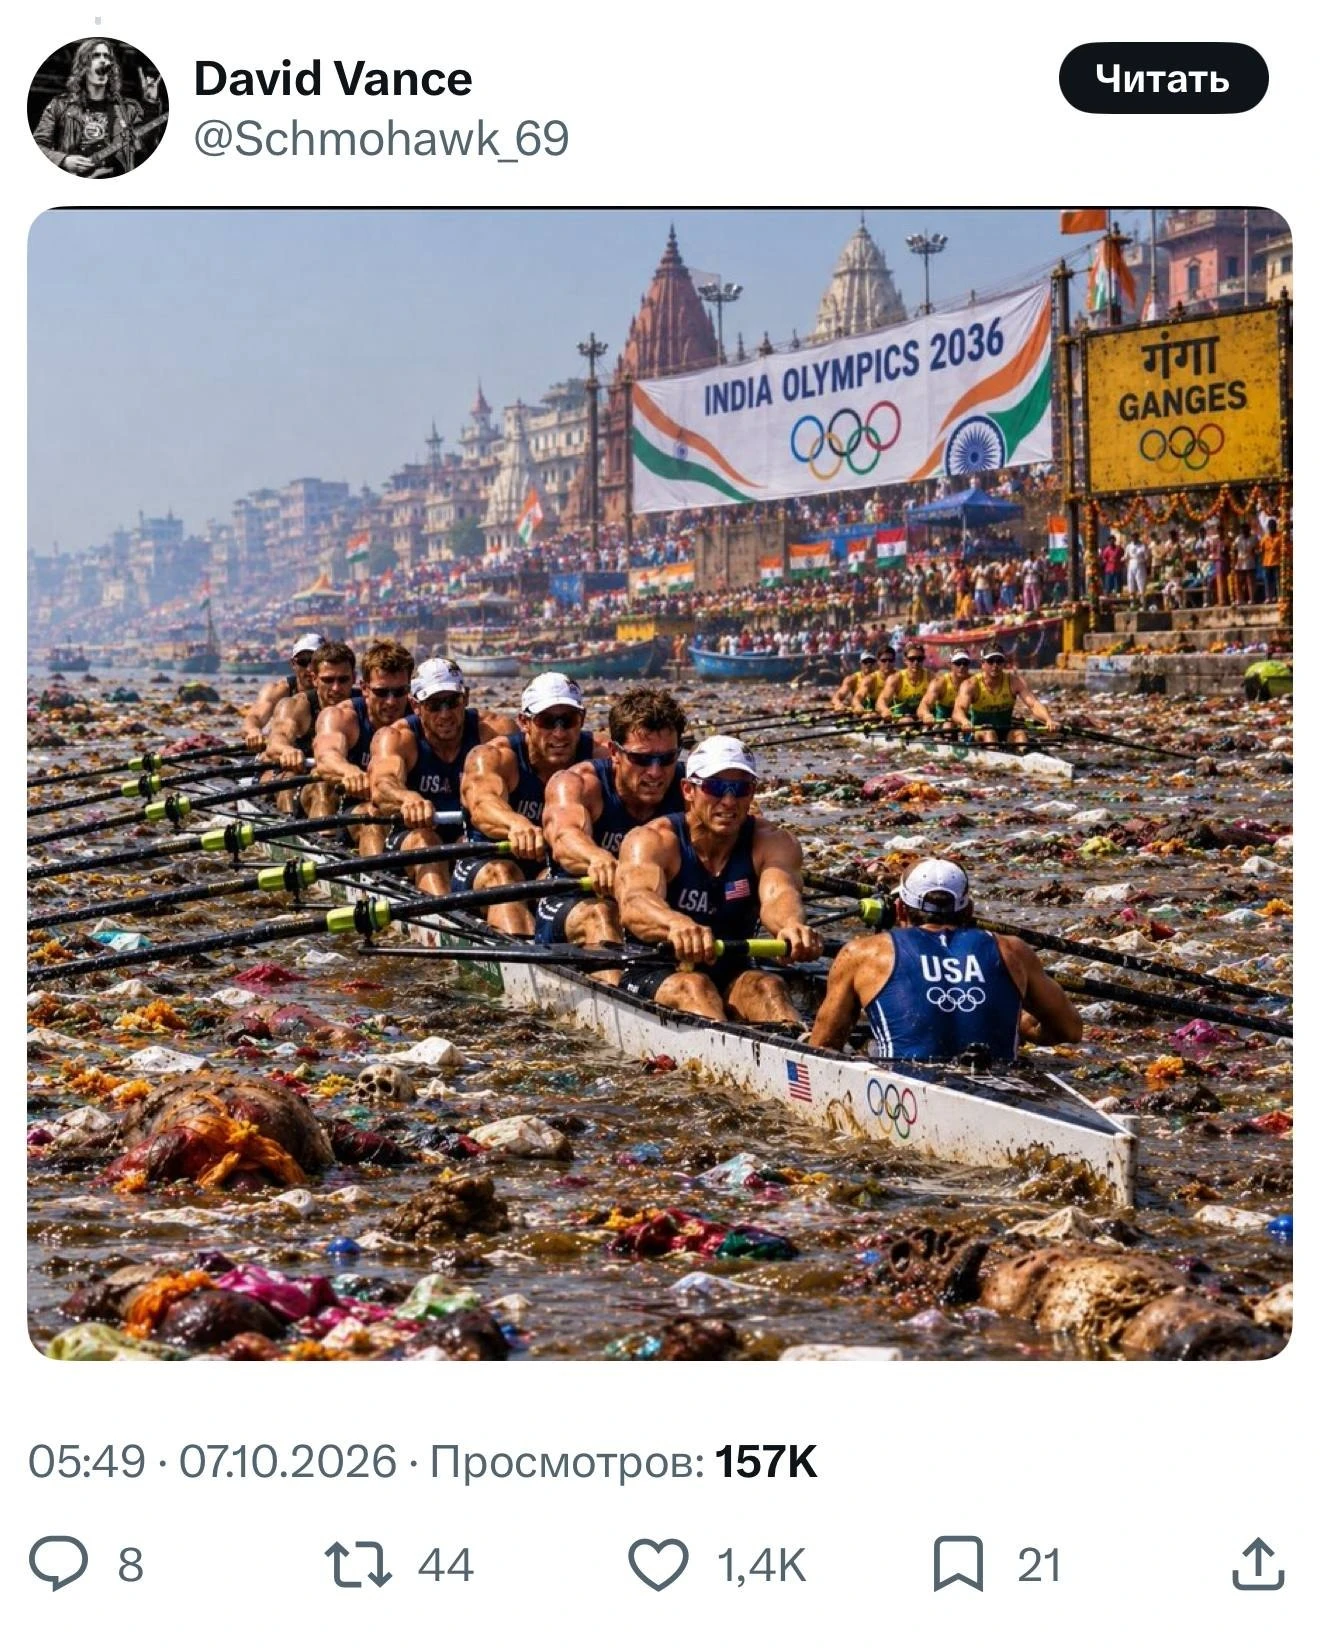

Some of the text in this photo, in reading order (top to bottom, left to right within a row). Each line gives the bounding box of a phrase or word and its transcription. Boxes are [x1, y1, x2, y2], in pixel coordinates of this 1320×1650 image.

[705, 316, 1004, 417] INDIA OLYMPICS 2036
[1141, 331, 1221, 379] गंगा
[1119, 380, 1248, 422] GANGES
[920, 954, 986, 984] USA
